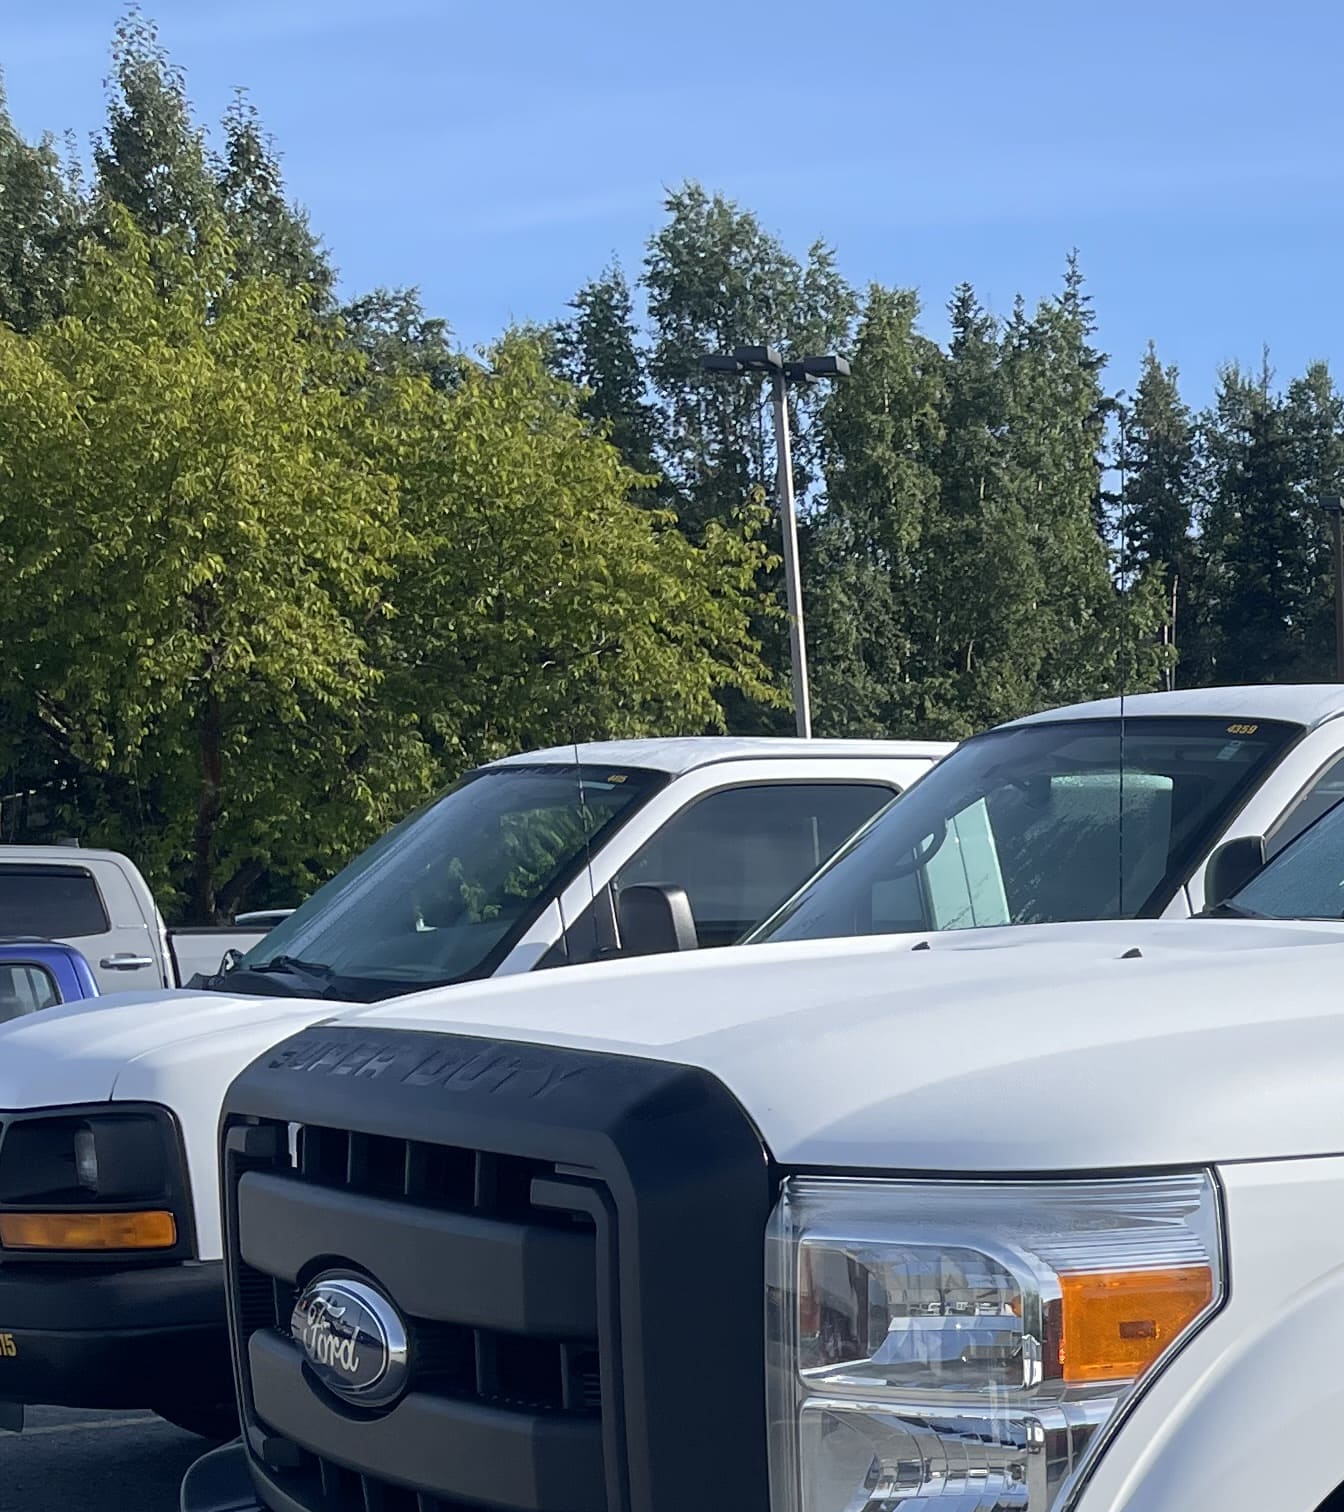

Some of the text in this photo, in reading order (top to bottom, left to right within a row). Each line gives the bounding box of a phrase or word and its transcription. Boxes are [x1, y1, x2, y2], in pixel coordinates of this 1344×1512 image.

[268, 1041, 591, 1098] SUPER DUTY
[304, 1297, 360, 1372] Ford
